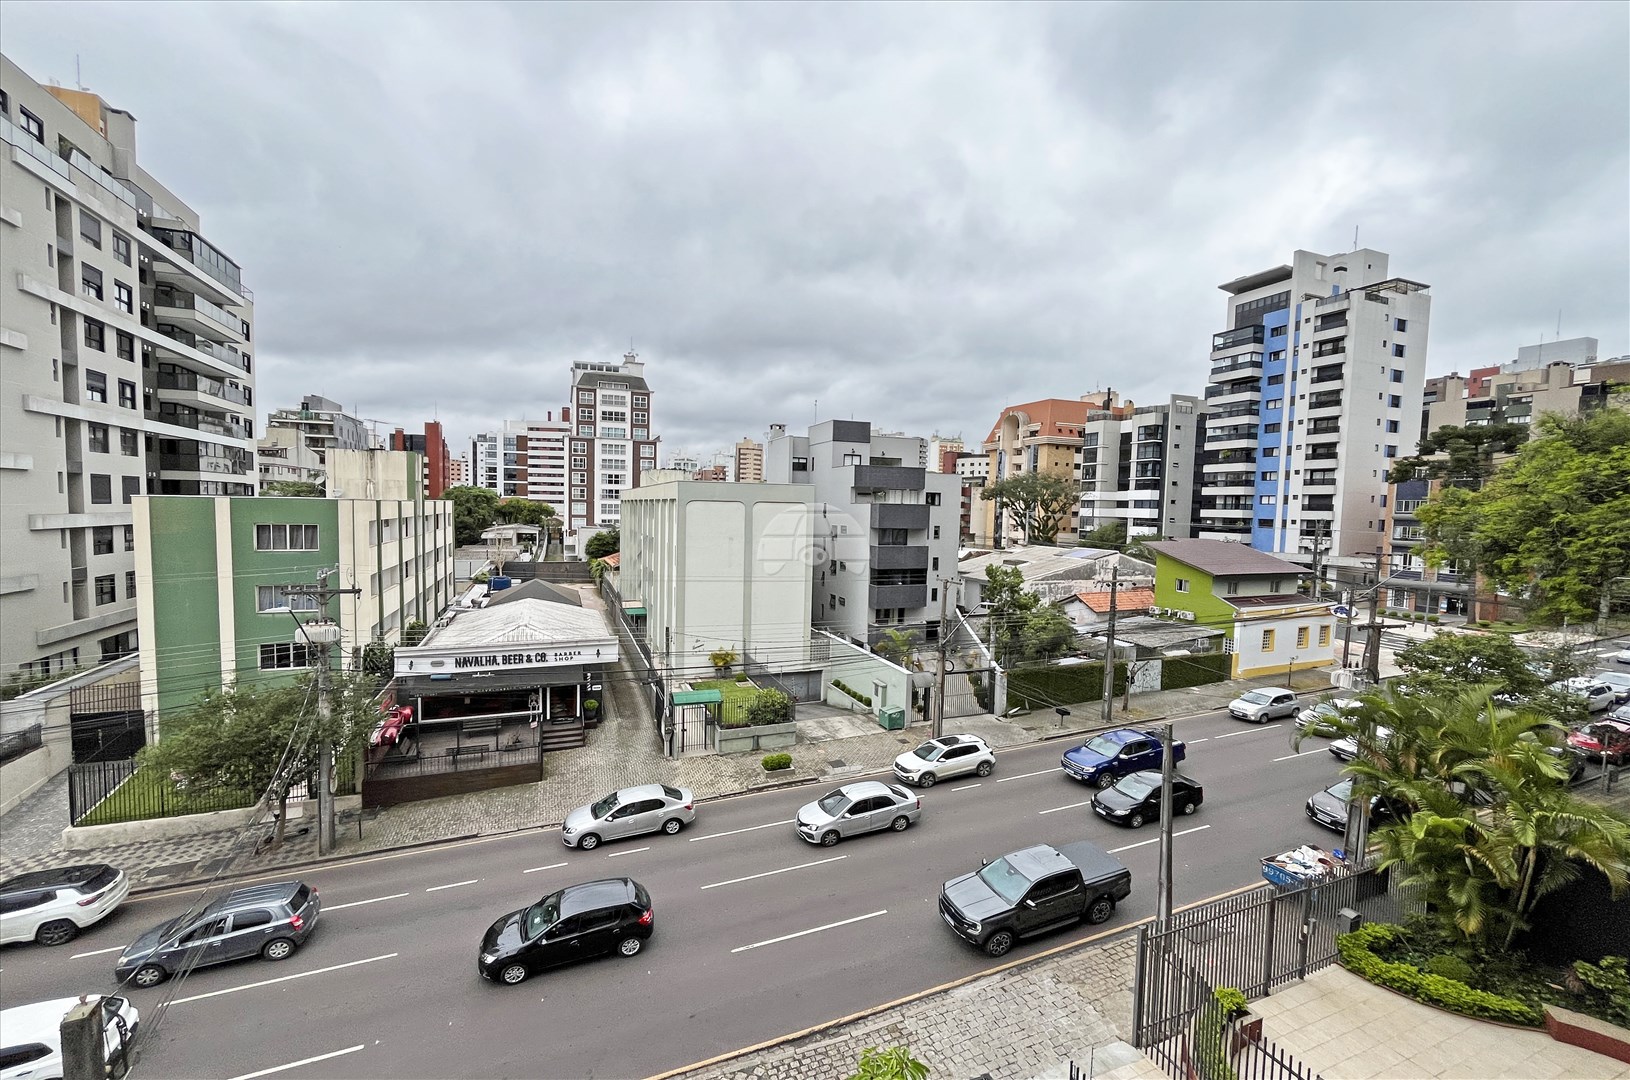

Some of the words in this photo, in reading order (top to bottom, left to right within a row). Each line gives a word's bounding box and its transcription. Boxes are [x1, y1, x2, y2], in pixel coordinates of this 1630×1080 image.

[454, 655, 500, 668] NAVALHA,
[502, 653, 524, 666] BEER
[525, 653, 533, 663] &
[535, 652, 548, 662] CO.
